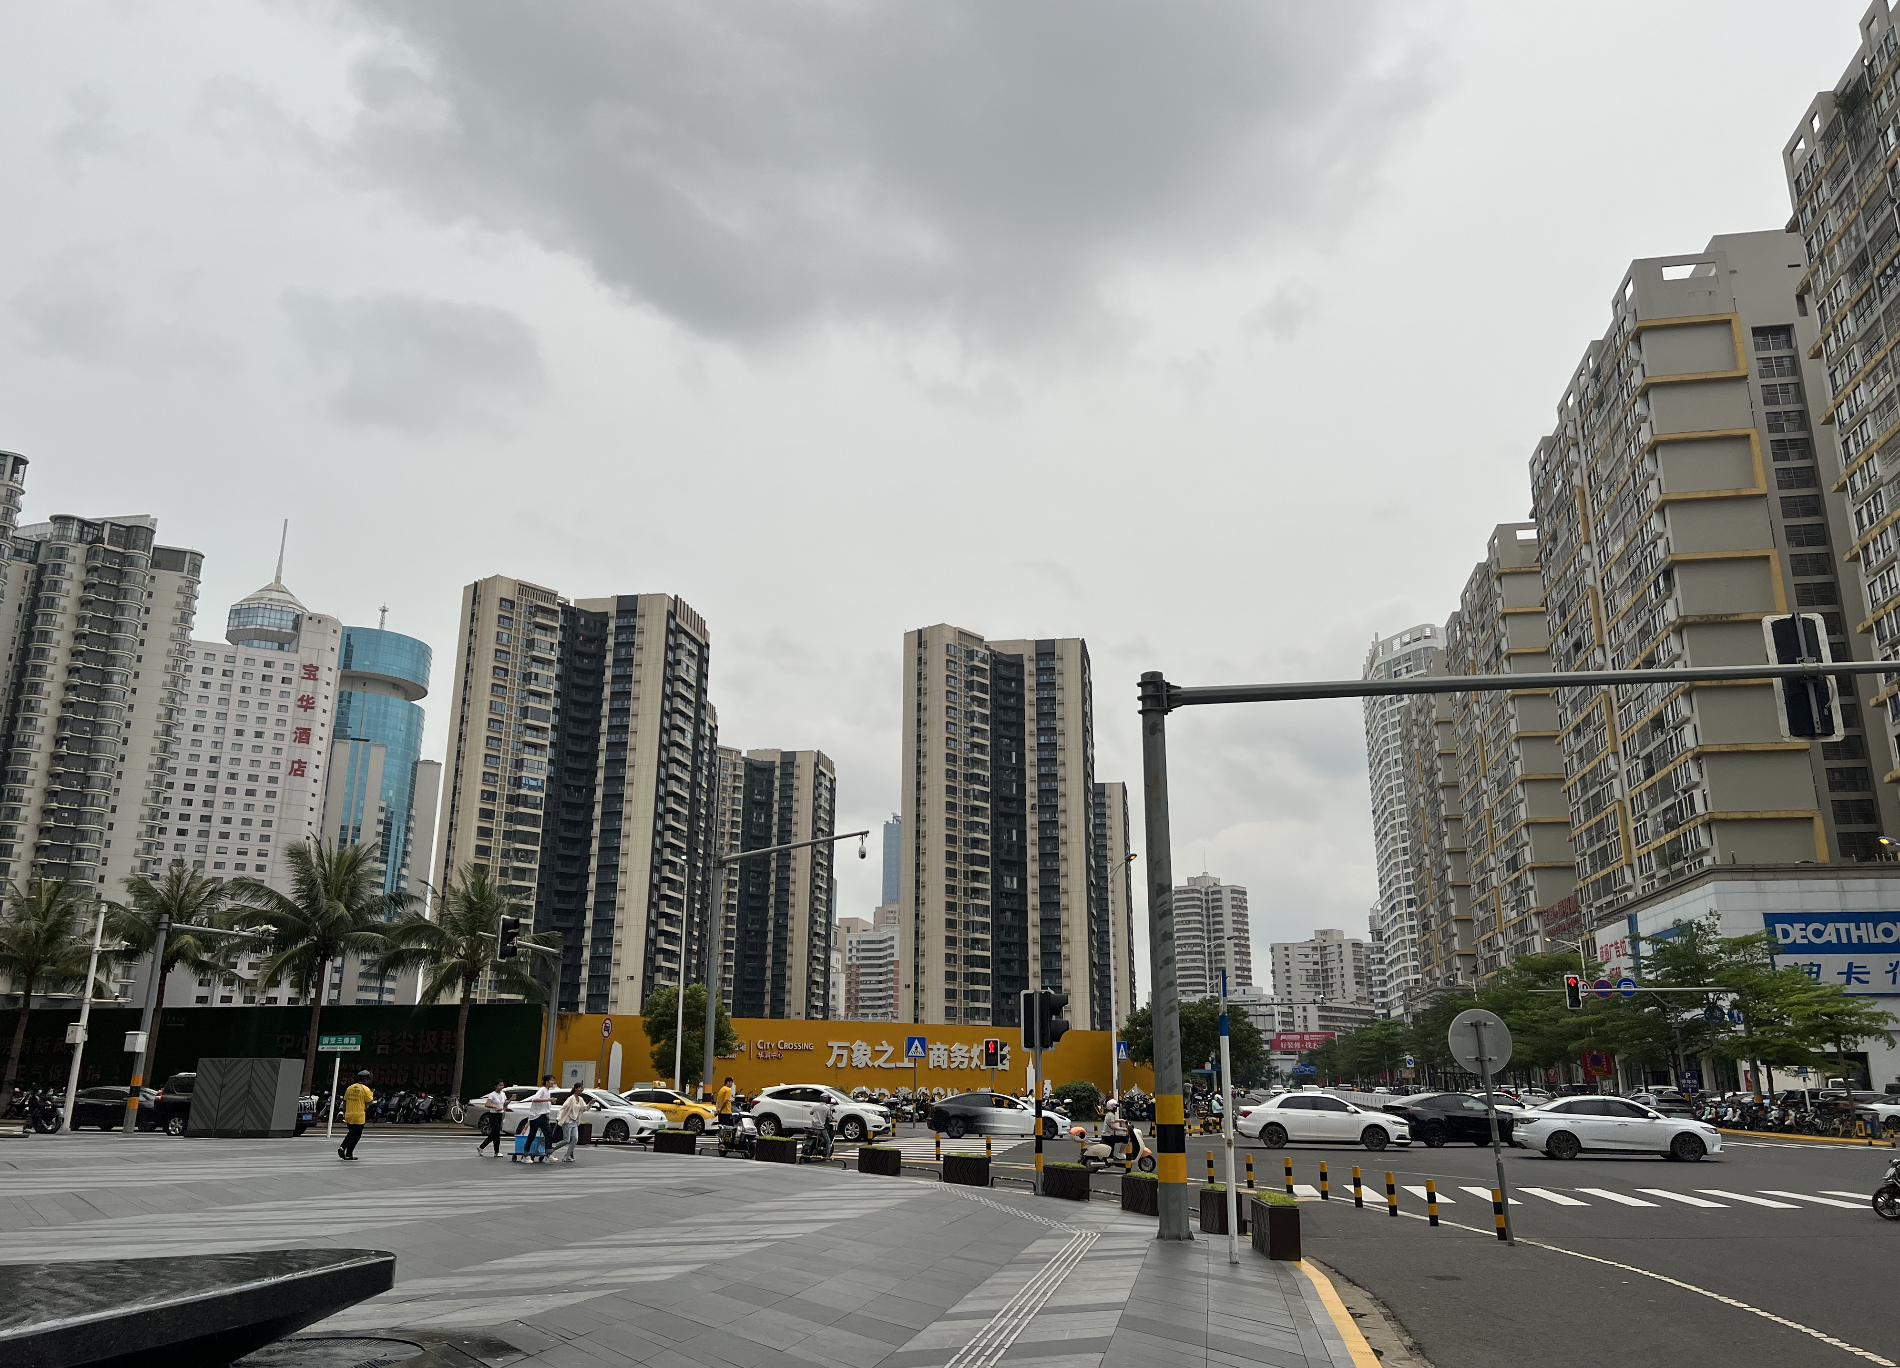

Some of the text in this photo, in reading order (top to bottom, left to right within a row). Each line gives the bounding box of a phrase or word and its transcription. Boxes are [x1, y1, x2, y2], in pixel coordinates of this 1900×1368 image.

[288, 663, 319, 778] 宝华酒店
[1774, 921, 1900, 944] DECATHLO
[757, 1051, 784, 1060] 华润中心
